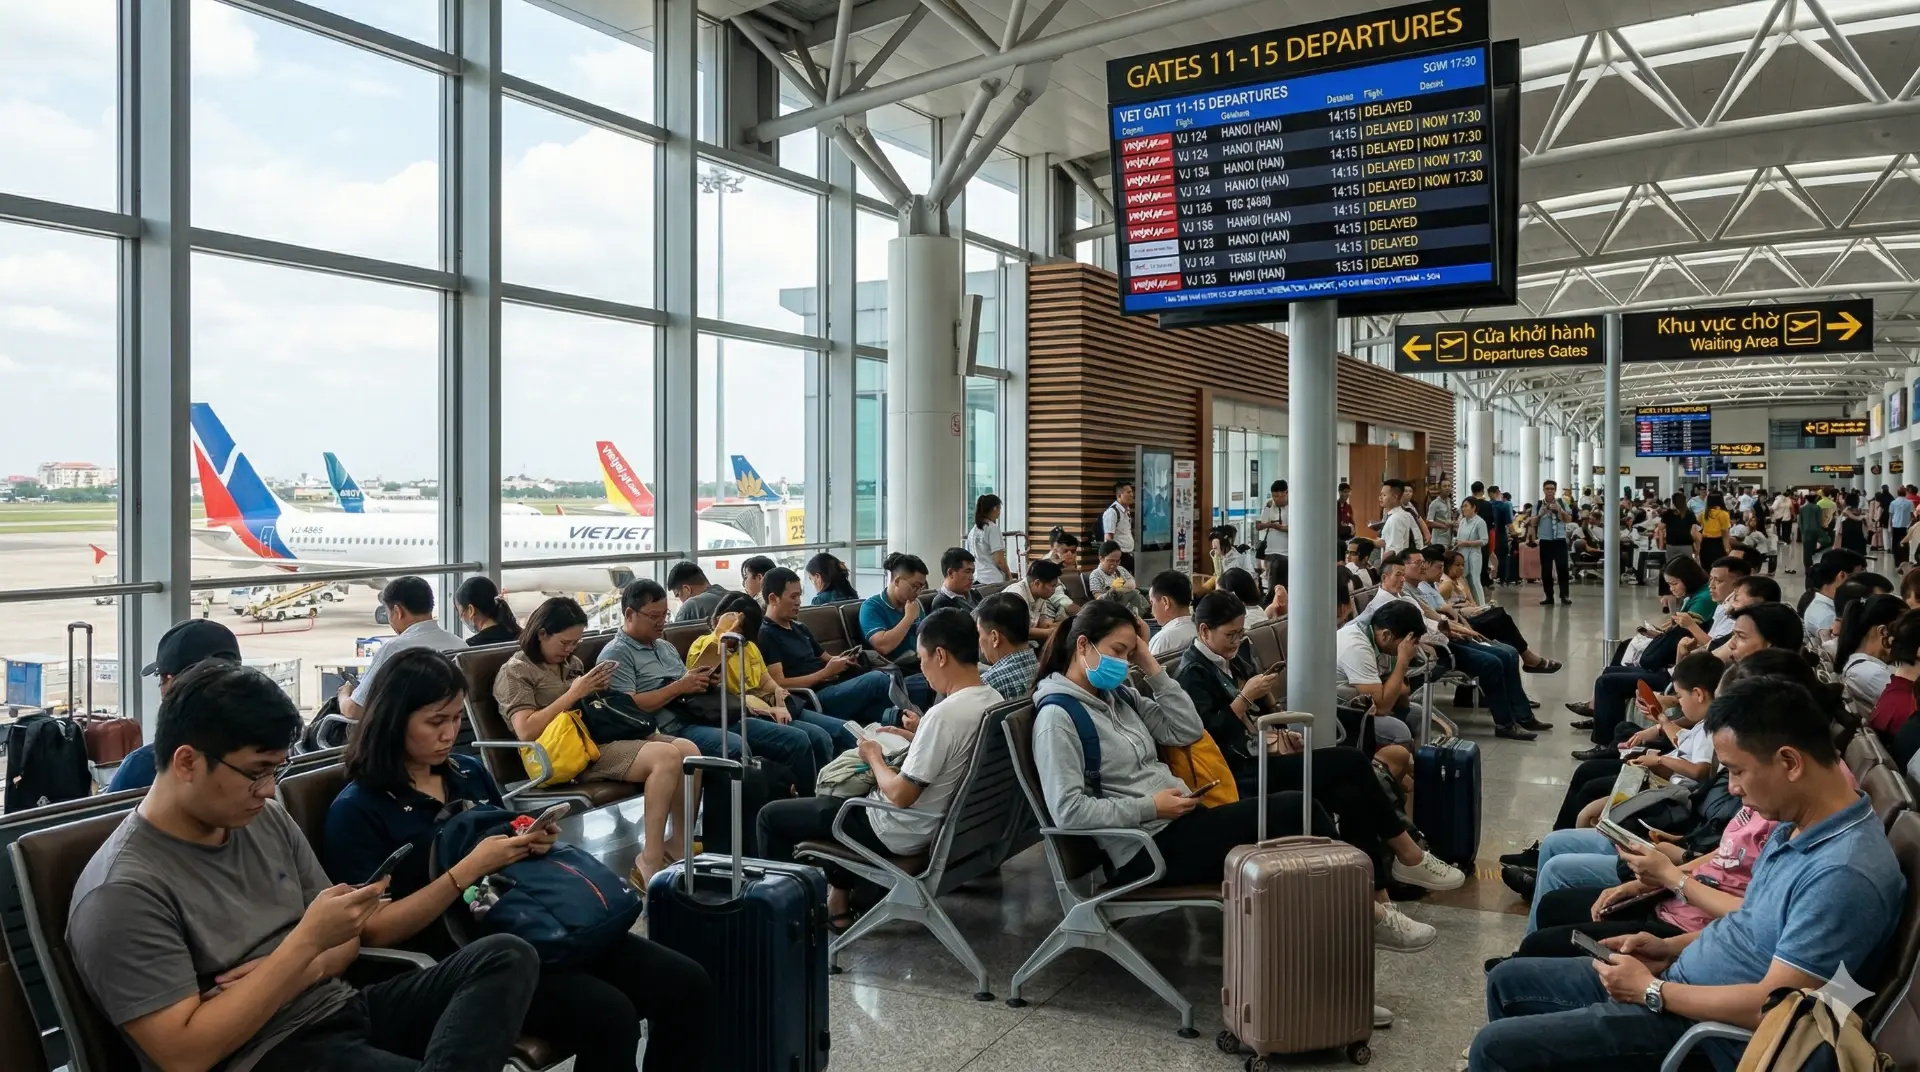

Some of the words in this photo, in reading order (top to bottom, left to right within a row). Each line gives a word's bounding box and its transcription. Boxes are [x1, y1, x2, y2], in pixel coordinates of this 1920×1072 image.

[1127, 55, 1202, 89] GATES
[1210, 42, 1279, 75] 11-15
[1287, 8, 1463, 63] DEPARTURES
[1450, 55, 1476, 69] 17:30
[1120, 109, 1141, 122] VET
[1144, 105, 1172, 119] GATT
[1176, 98, 1206, 115] 11-15
[1209, 85, 1288, 109] DEPARTURES
[1177, 134, 1188, 145] VJ
[1192, 131, 1207, 142] 124
[1221, 124, 1251, 138] HANOI
[1255, 119, 1282, 135] (HAN)
[1328, 109, 1356, 123] 14:15
[1365, 100, 1412, 117] DELAYED
[1178, 151, 1189, 162] VJ
[1193, 149, 1208, 160] 124
[1223, 142, 1253, 156] HANOI
[1256, 137, 1283, 154] (HAN)
[1329, 127, 1357, 142] 14:15
[1366, 119, 1413, 137] DELAYED
[1423, 114, 1449, 129] NOW
[1451, 110, 1481, 125] 17:30
[1179, 169, 1191, 180] VJ
[1224, 160, 1254, 175] HANOI
[1257, 156, 1285, 172] (HAN)
[1330, 146, 1358, 161] 14:15
[1367, 139, 1414, 156] DELAYED
[1423, 134, 1449, 148] NOW
[1452, 129, 1482, 144] 17:30
[1180, 187, 1192, 198] VJ
[1195, 185, 1211, 196] 124
[1261, 174, 1289, 191] (HAN)
[1331, 165, 1358, 179] 14:15
[1368, 158, 1415, 175] DELAYED
[1424, 153, 1450, 167] NOW
[1453, 149, 1483, 165] 17:30
[1182, 204, 1193, 215] VJ
[1332, 184, 1360, 198] 14:15
[1368, 178, 1416, 194] DELAYED
[1425, 173, 1450, 187] NOW
[1454, 169, 1483, 184] 17:30
[1183, 222, 1194, 233] VJ
[1263, 210, 1291, 226] (HAN)
[1333, 203, 1360, 216] 14:15
[1369, 197, 1417, 213] DELAYED
[1184, 240, 1195, 251] VJ
[1228, 232, 1259, 246] HANOI
[1261, 229, 1290, 245] (HAN)
[1334, 222, 1361, 235] 14:15
[1370, 216, 1418, 232] DELAYED
[1185, 258, 1196, 268] VJ
[1259, 248, 1286, 263] (HAN)
[1335, 241, 1362, 254] 14:15
[1371, 235, 1419, 250] DELAYED
[1186, 275, 1197, 286] VJ
[1257, 267, 1285, 282] (HAN)
[1371, 255, 1419, 270] DELAYED
[1473, 327, 1505, 344] Cửa
[1510, 324, 1546, 342] khởi
[1552, 322, 1595, 341] hành
[1658, 317, 1695, 334] Khu
[1701, 317, 1736, 336] vực
[1742, 312, 1780, 330] chờ
[1473, 347, 1545, 363] Departures
[1549, 345, 1588, 358] Gates
[1690, 337, 1741, 352] Waiting
[1745, 336, 1779, 348] Area
[569, 526, 655, 540] VIETJET
